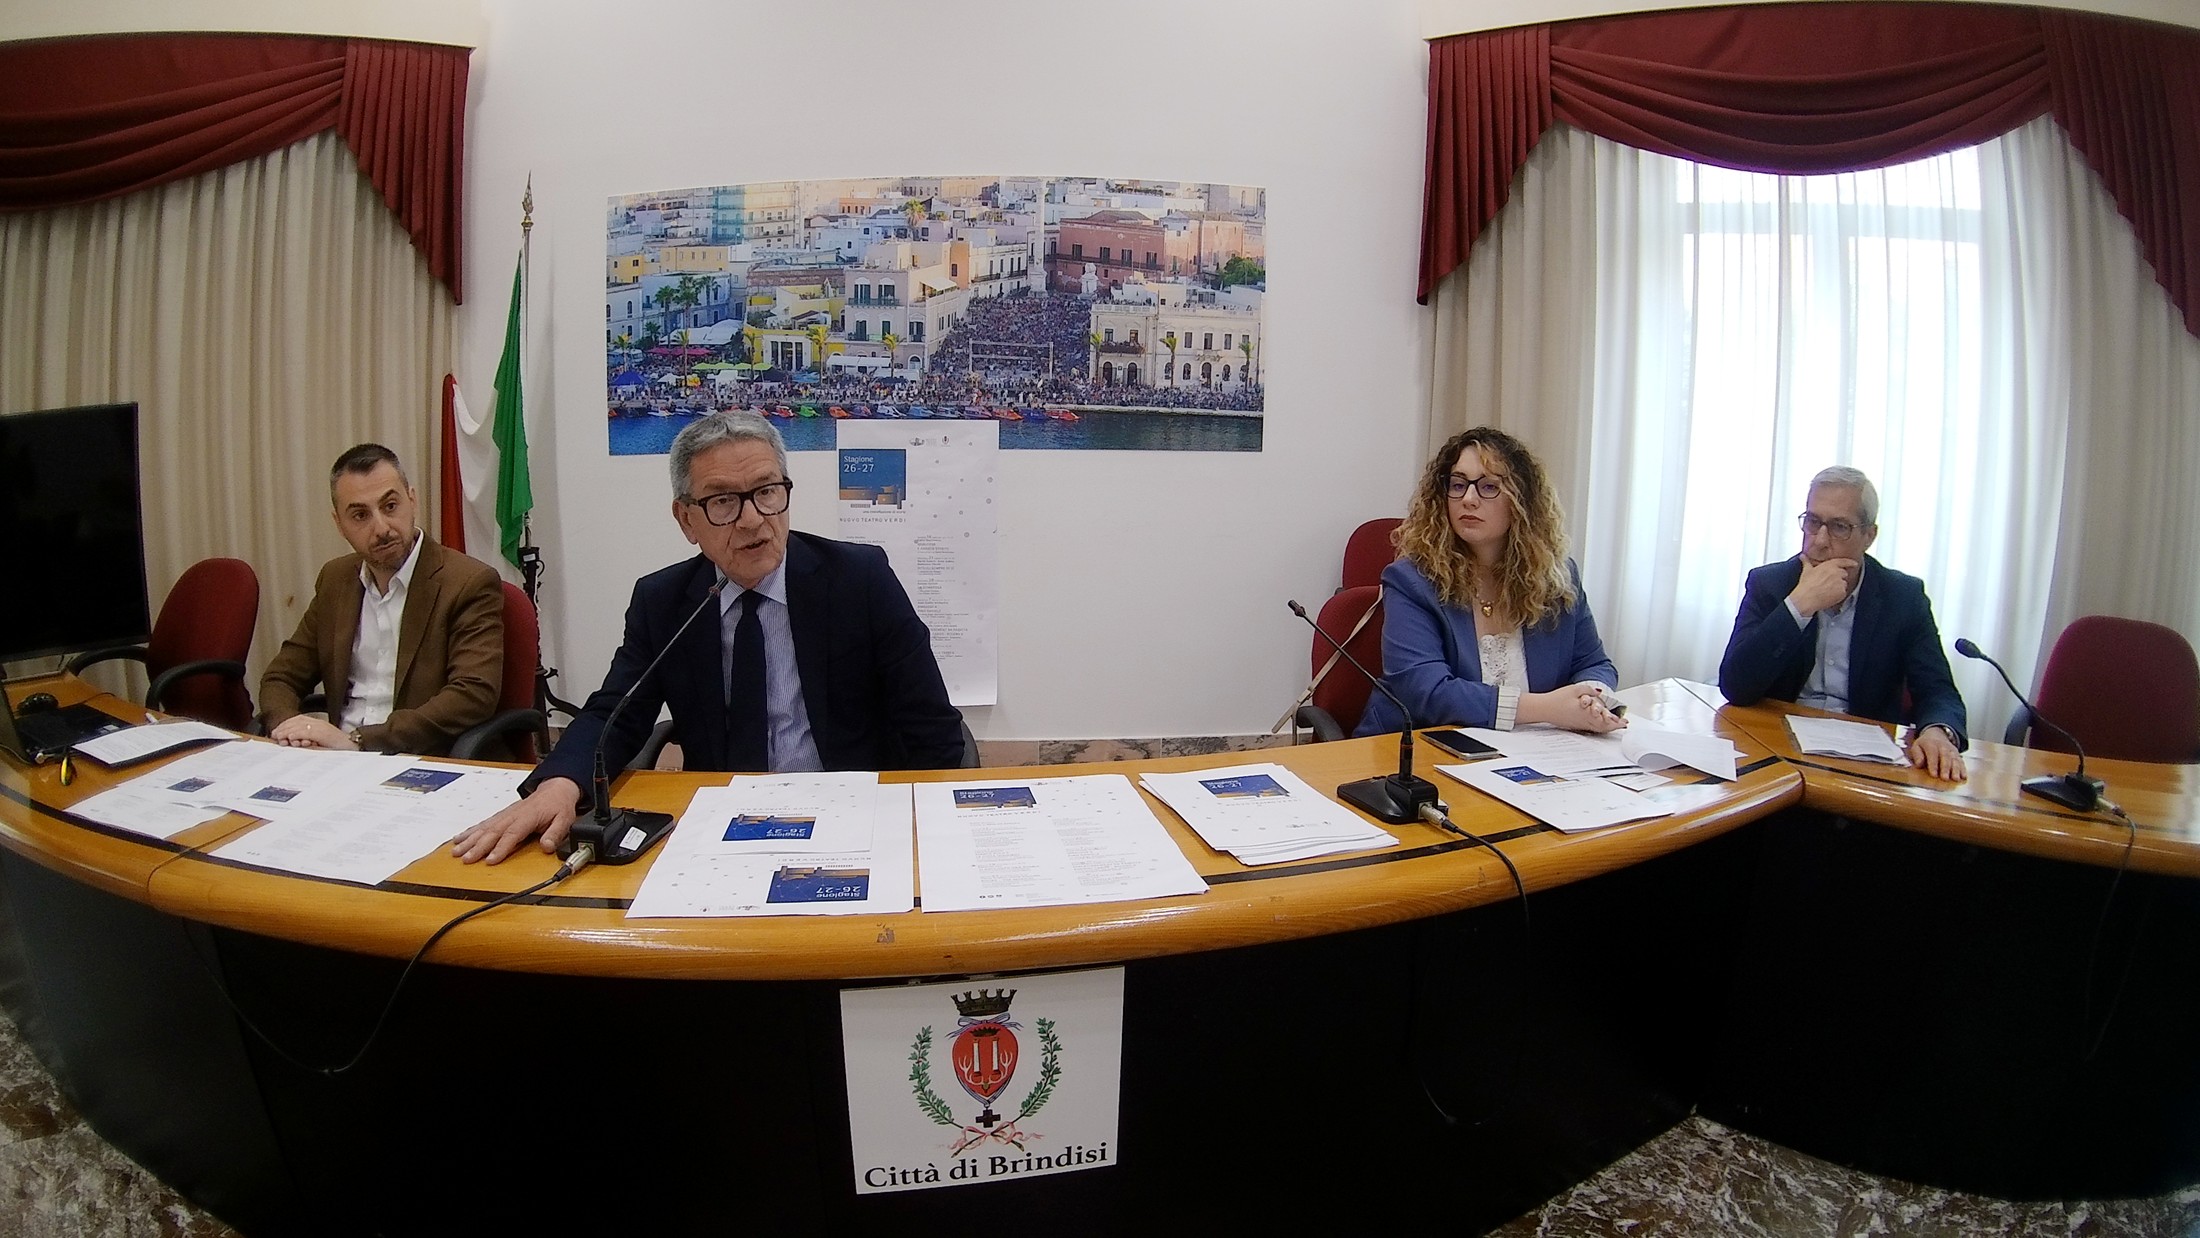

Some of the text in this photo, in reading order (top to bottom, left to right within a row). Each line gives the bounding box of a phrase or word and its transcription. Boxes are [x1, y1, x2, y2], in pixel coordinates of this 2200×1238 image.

[843, 455, 874, 464] Stagione
[843, 463, 875, 473] 26-27
[864, 1142, 1108, 1188] Città di Brindisi
